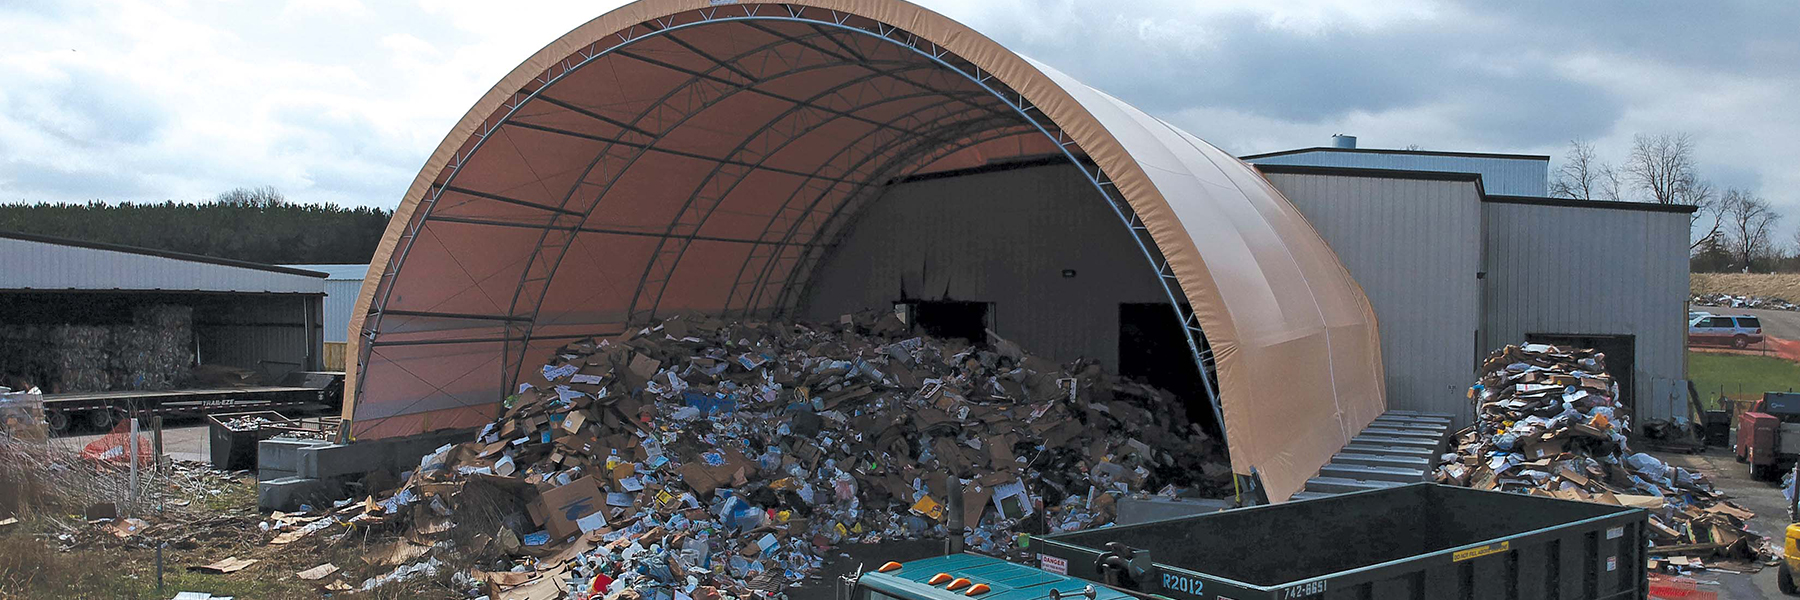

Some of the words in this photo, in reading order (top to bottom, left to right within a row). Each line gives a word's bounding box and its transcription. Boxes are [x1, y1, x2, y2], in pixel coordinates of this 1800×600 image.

[1043, 556, 1065, 566] DANGER
[1163, 573, 1204, 596] R2012
[1284, 580, 1327, 599] 742-8651
